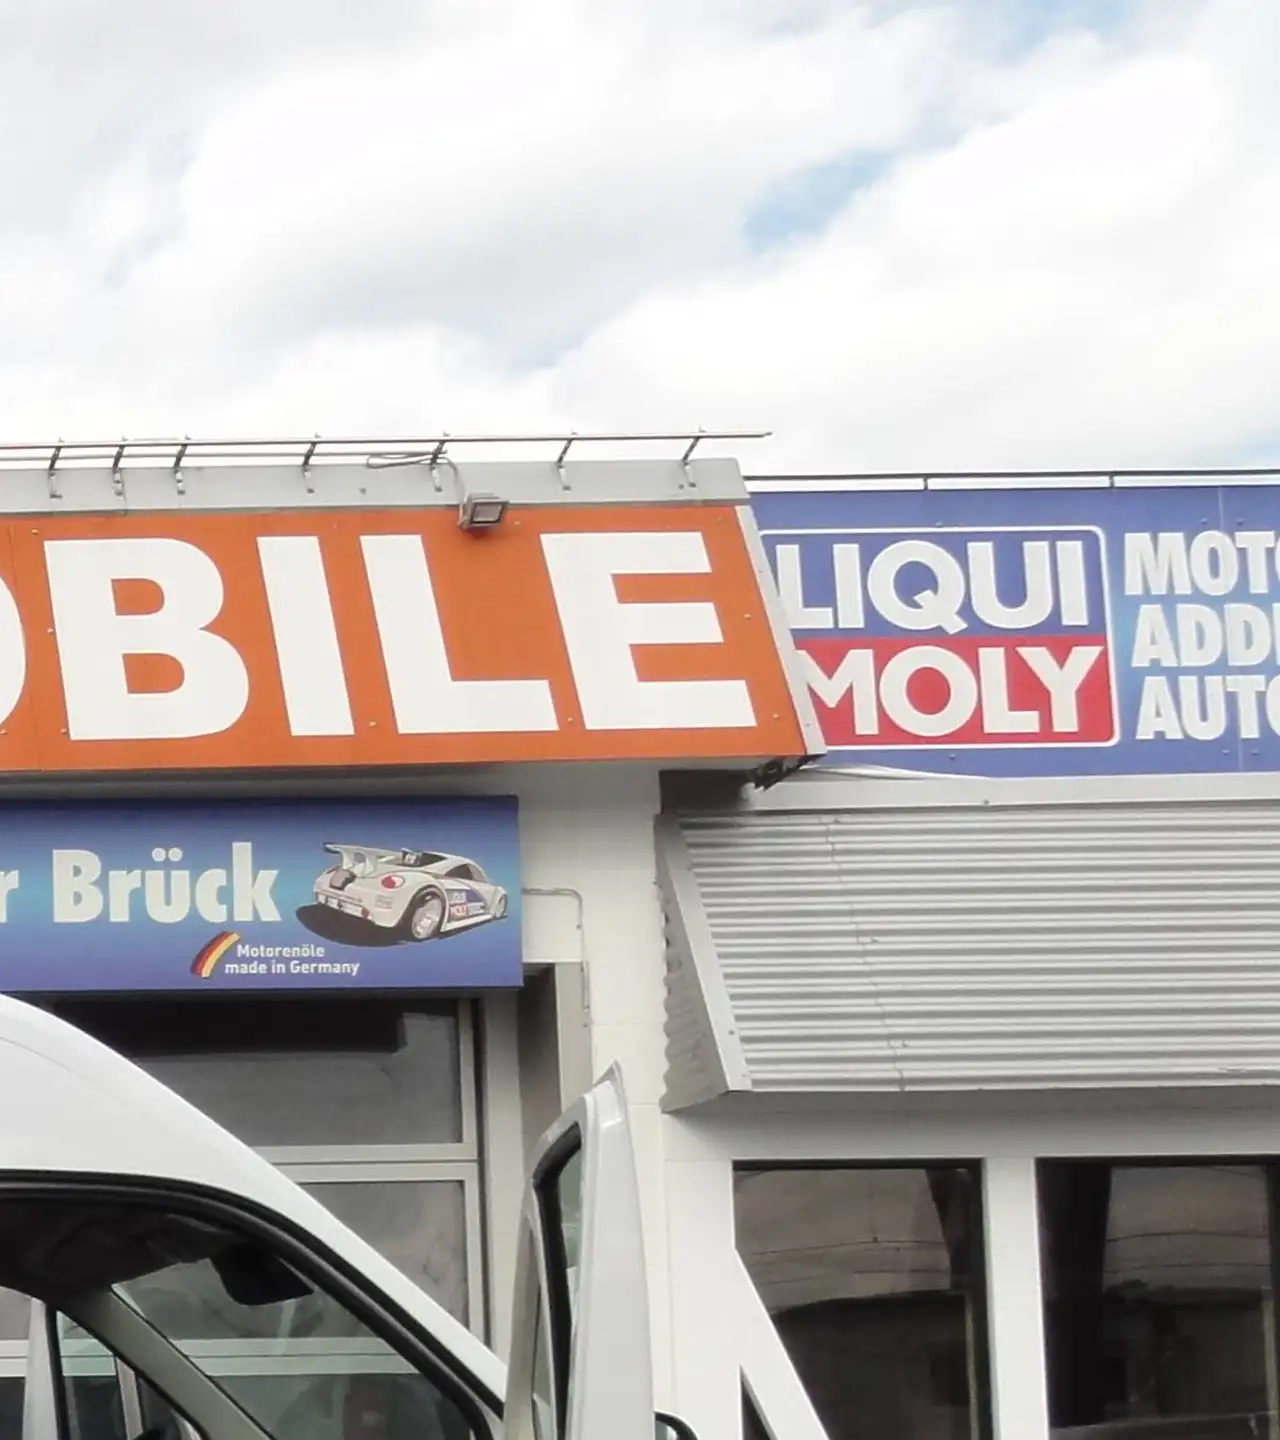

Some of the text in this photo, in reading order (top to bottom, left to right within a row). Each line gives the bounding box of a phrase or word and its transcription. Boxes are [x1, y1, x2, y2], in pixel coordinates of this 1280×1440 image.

[775, 540, 1090, 634] LIQUI
[1124, 530, 1280, 596] MOT
[796, 645, 1104, 738] MOLY
[51, 841, 282, 925] Brück
[224, 959, 360, 977] made in Germany
[236, 942, 326, 958] Motorenöle
